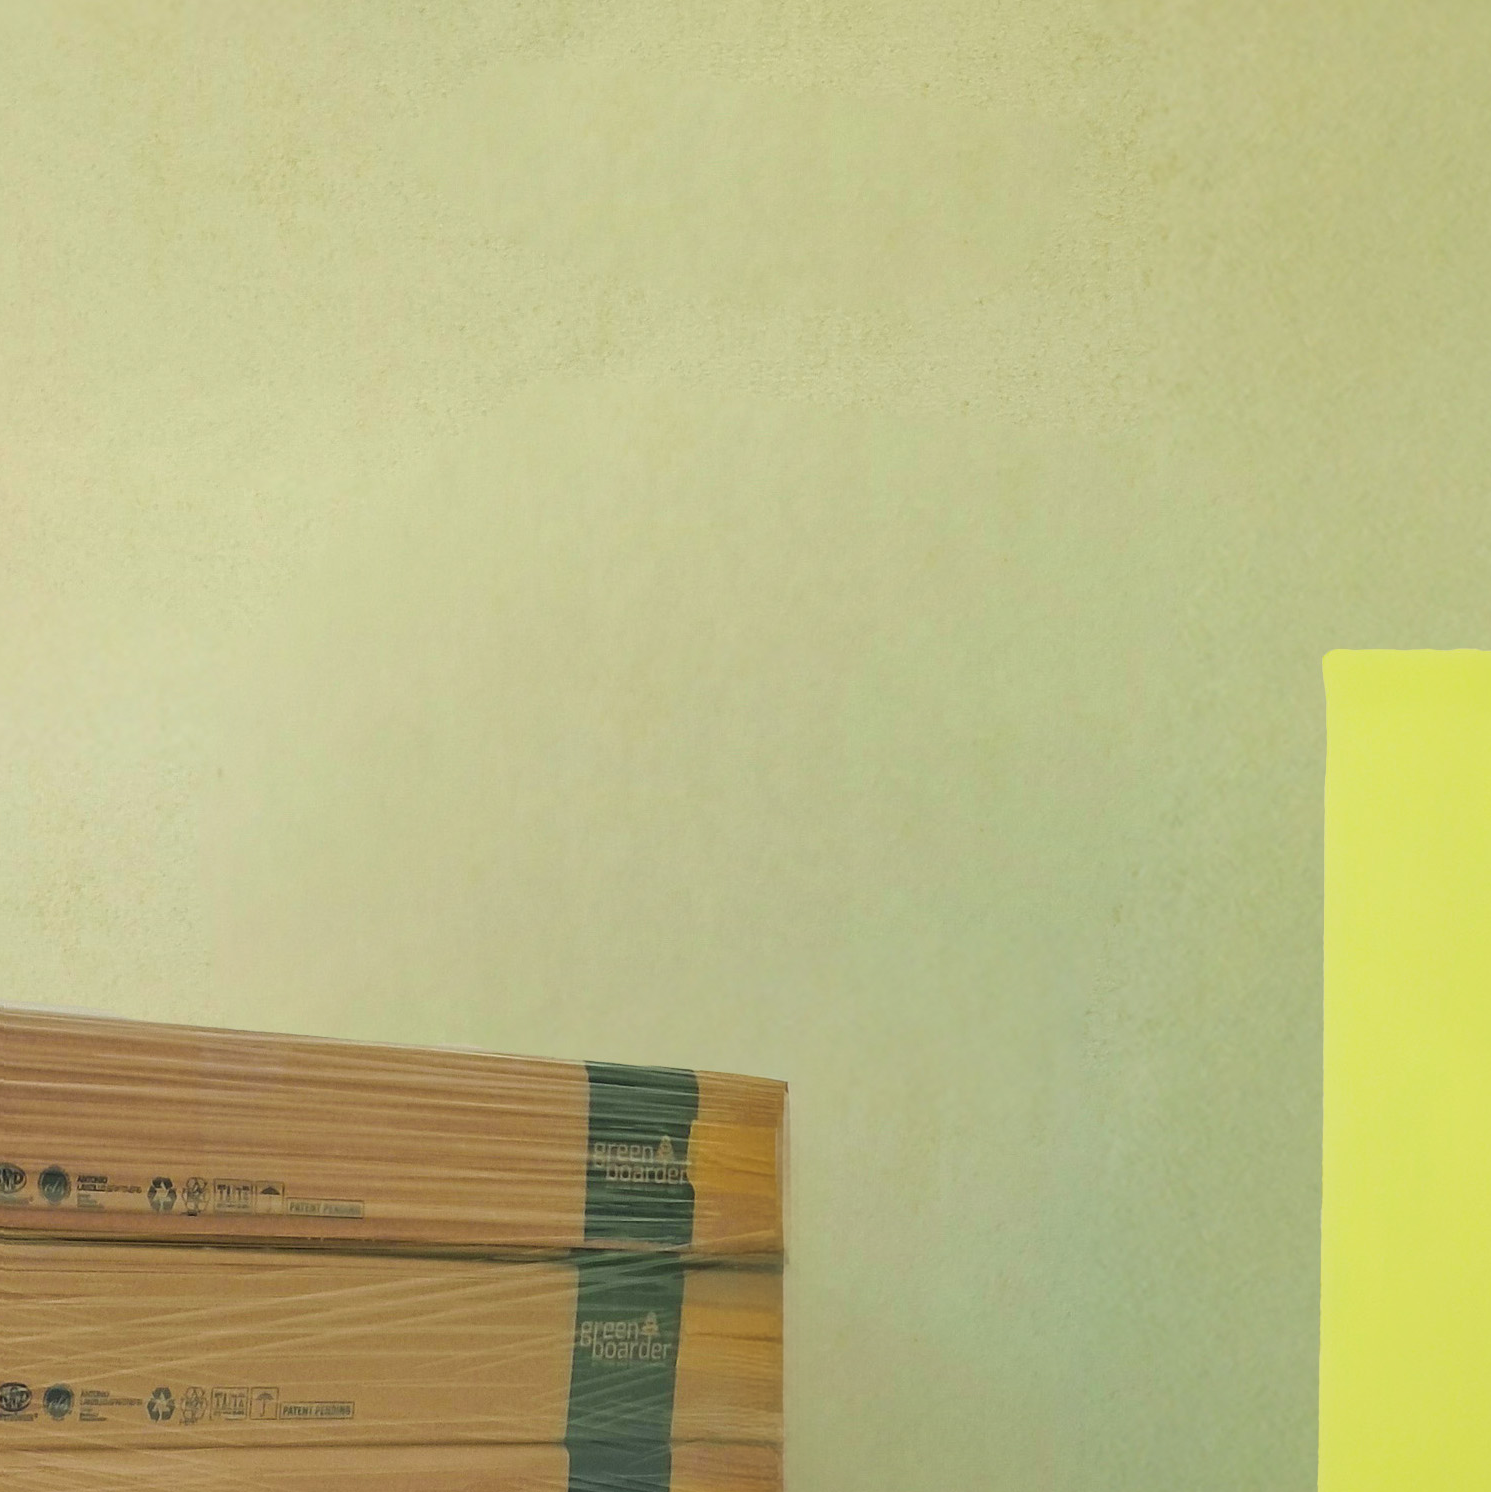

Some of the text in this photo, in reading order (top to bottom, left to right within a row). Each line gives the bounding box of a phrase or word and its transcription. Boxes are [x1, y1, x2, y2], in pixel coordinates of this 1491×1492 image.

[593, 1142, 654, 1168] green
[580, 1321, 639, 1347] green
[592, 1339, 671, 1359] boarder
[283, 1404, 312, 1418] PATENT
